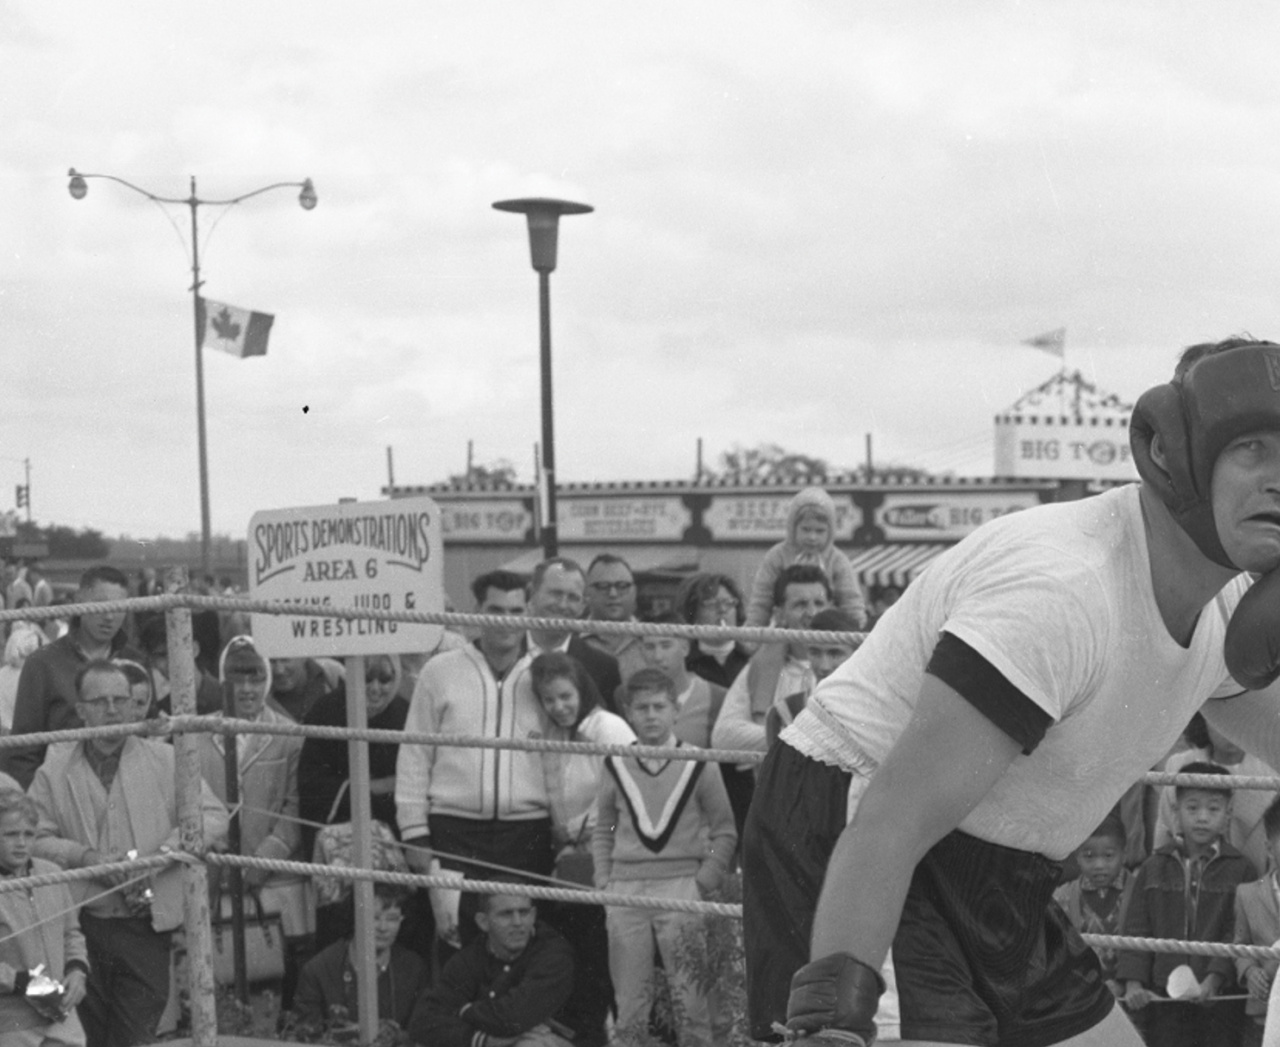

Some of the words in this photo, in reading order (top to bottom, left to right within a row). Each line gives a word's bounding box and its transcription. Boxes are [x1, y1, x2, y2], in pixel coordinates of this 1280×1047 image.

[1020, 439, 1060, 460] BIG
[949, 507, 984, 525] BIG
[255, 519, 309, 573] SPORTS
[312, 512, 430, 564] DEMONSTRATIONS
[303, 559, 358, 583] AREA
[365, 558, 378, 579] 6
[404, 592, 416, 609] &
[292, 617, 398, 638] WRESTLING
